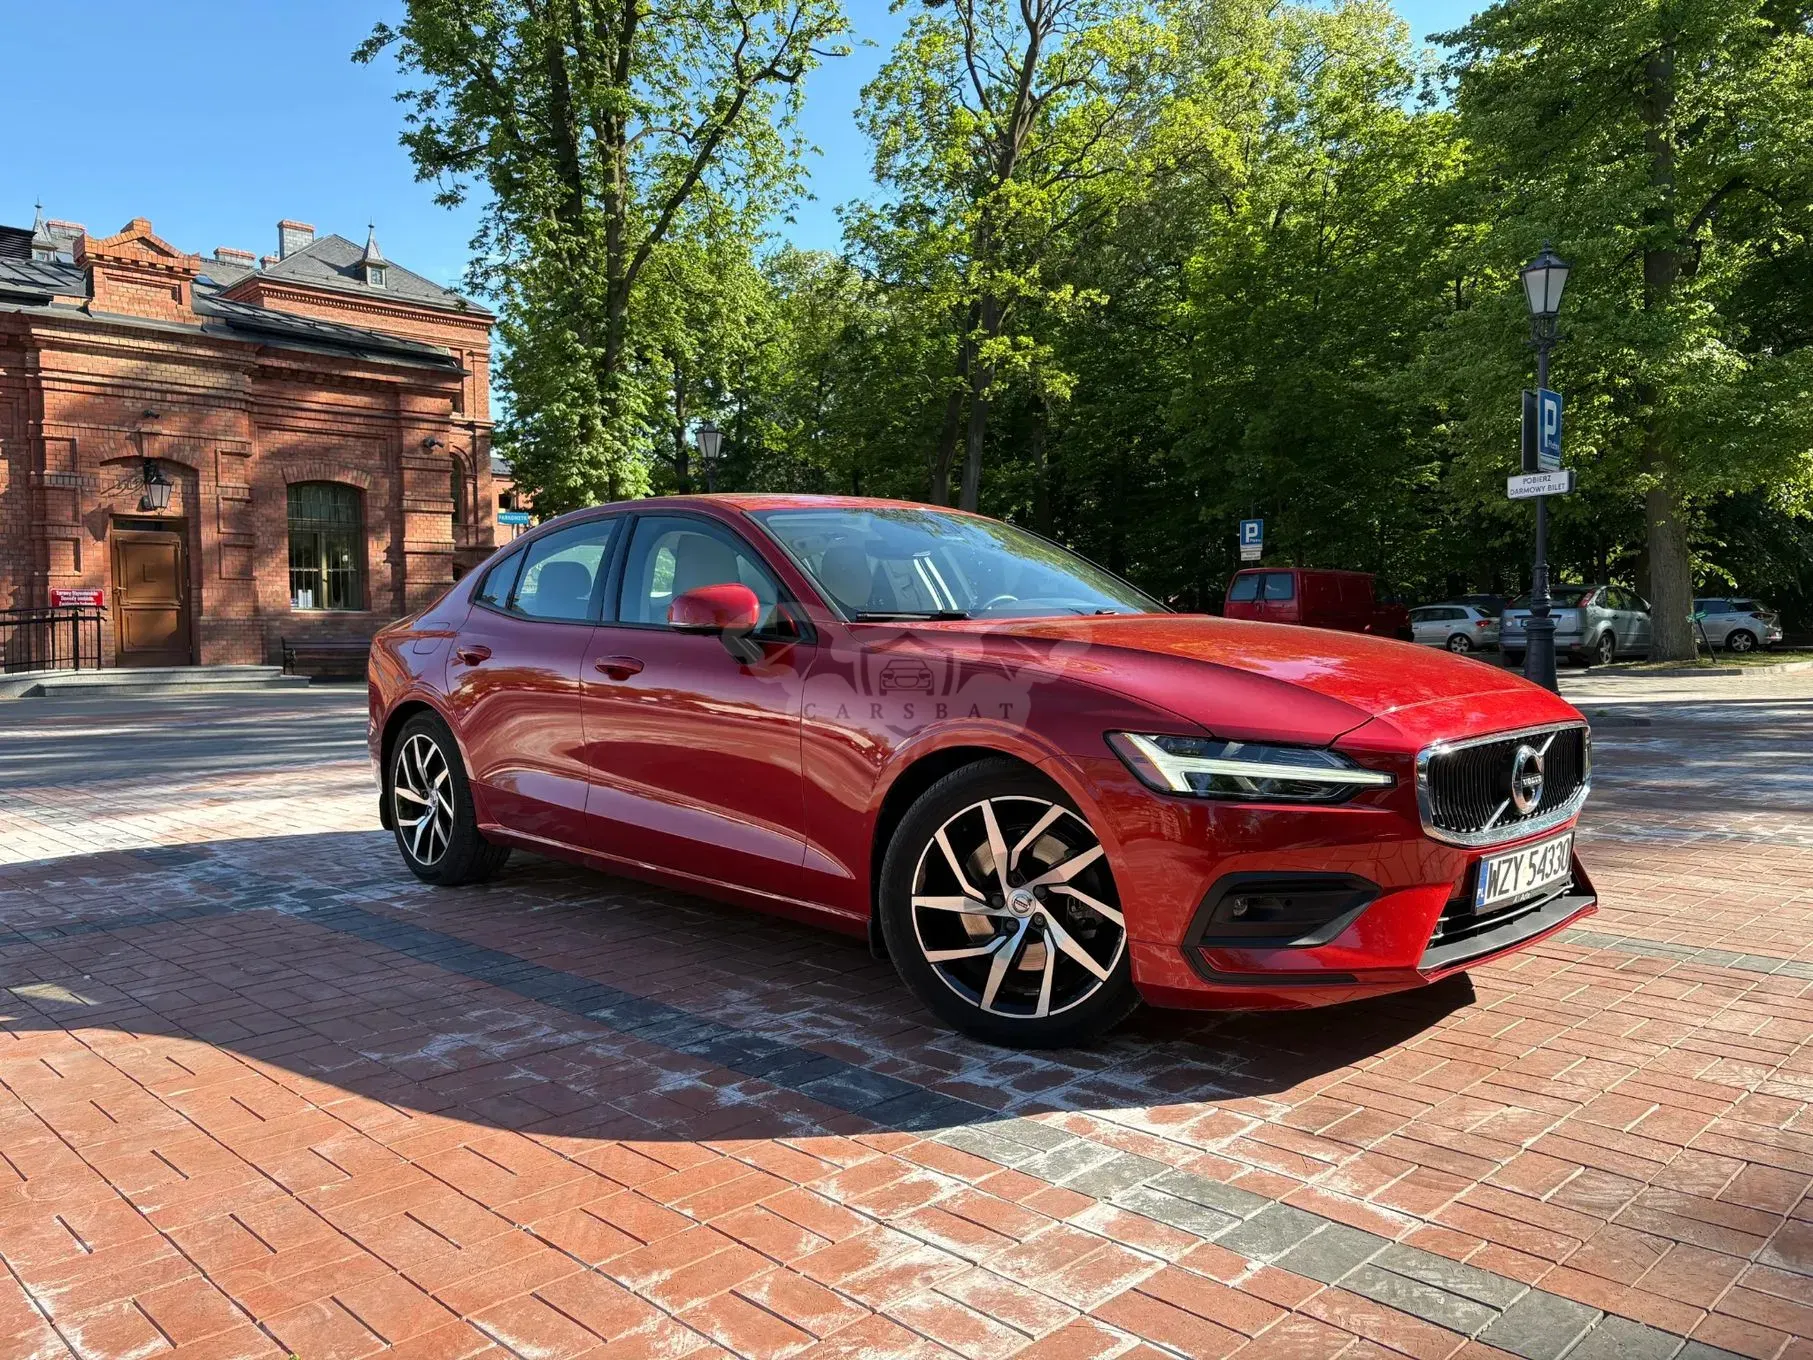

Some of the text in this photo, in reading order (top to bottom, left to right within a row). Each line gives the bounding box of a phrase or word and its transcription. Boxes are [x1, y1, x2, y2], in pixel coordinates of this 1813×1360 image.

[1545, 399, 1557, 447] P
[1510, 483, 1565, 495] DARMOWY BILET
[1523, 475, 1551, 484] POBIERZ
[1246, 523, 1258, 543] P
[1486, 838, 1570, 899] WZY 54330
